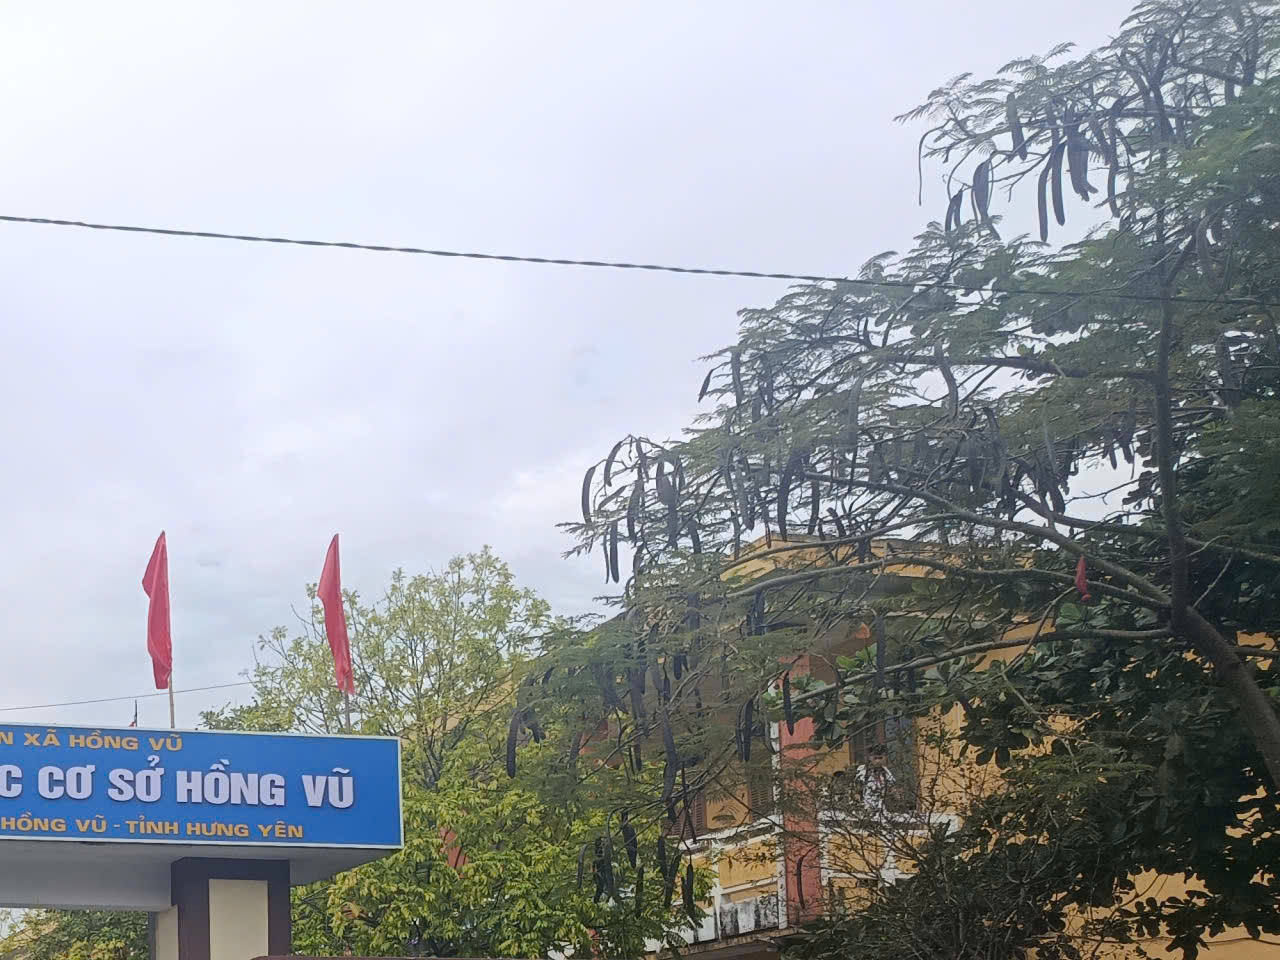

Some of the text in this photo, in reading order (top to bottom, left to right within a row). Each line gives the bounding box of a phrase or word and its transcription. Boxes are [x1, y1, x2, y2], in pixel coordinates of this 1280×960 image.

[23, 729, 61, 746] XÃ
[69, 730, 139, 751] HỒNG
[148, 734, 183, 751] VŨ
[38, 764, 97, 800] CƠ
[107, 755, 165, 803] SỞ
[176, 759, 286, 807] HỒNG
[301, 767, 355, 809] VŨ
[1, 811, 67, 832] HỒNG
[75, 815, 108, 833] VŨ
[125, 815, 179, 835] TỈNH
[186, 822, 250, 838] HƯNG
[257, 820, 305, 838] YÊN
